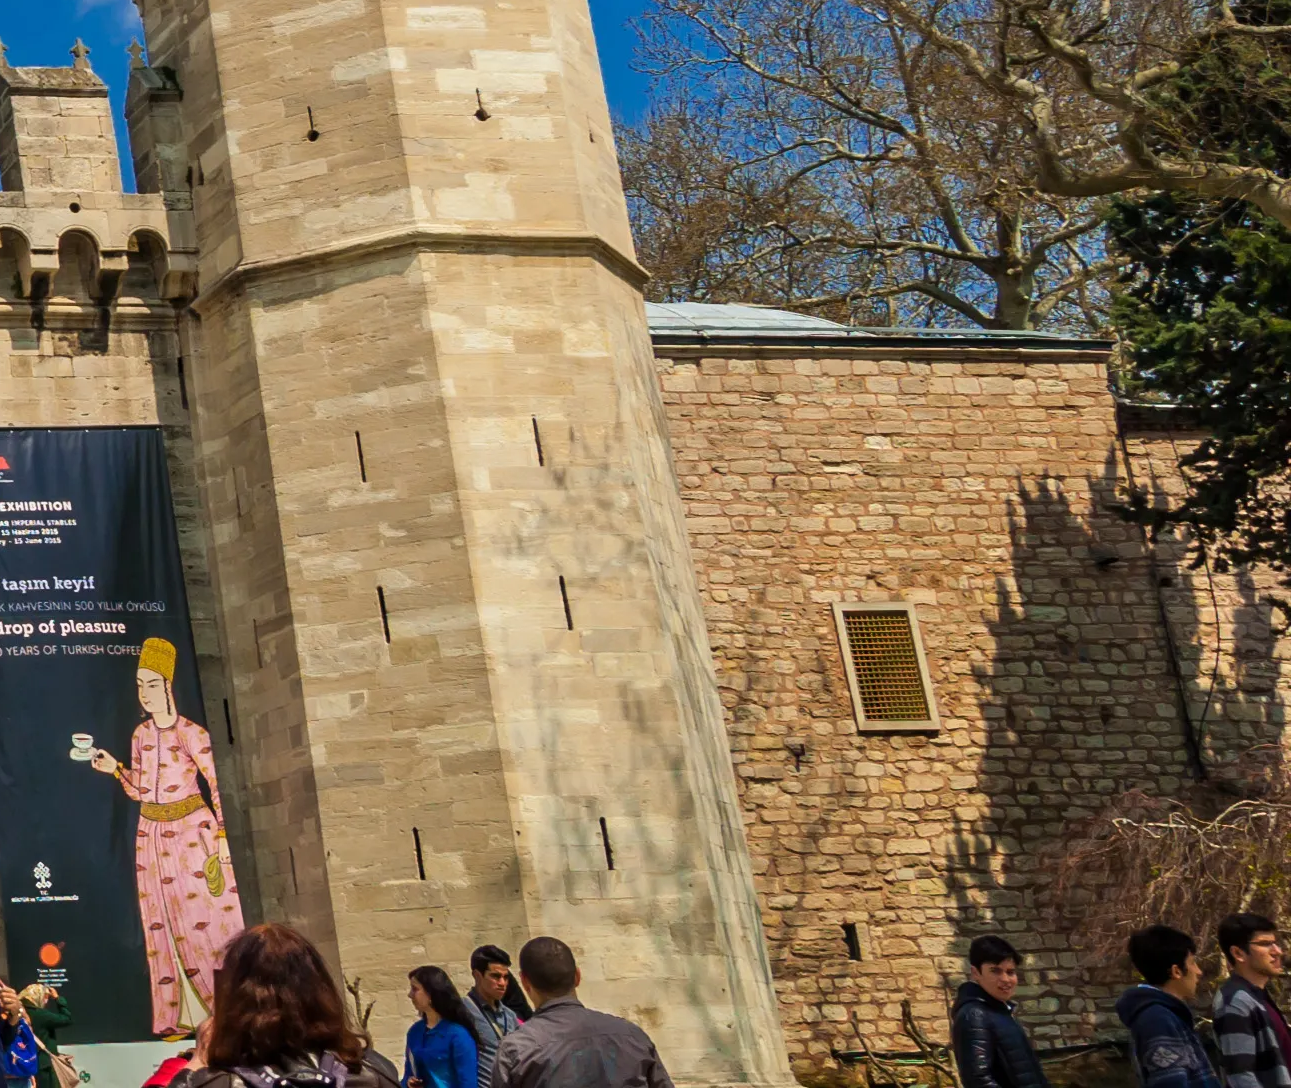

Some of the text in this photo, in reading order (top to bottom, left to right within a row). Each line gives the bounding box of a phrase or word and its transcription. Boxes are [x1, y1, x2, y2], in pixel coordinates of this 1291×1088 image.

[0, 500, 72, 512] EXHIBITION
[2, 578, 50, 594] taşım
[54, 576, 95, 592] keyif
[74, 601, 94, 611] 500
[97, 602, 124, 611] YILLIK
[38, 620, 55, 633] of
[60, 620, 126, 636] pleasure
[6, 645, 40, 656] YEARS
[42, 645, 58, 655] OF
[61, 644, 104, 655] TURKISH
[107, 645, 141, 656] COFFEE
